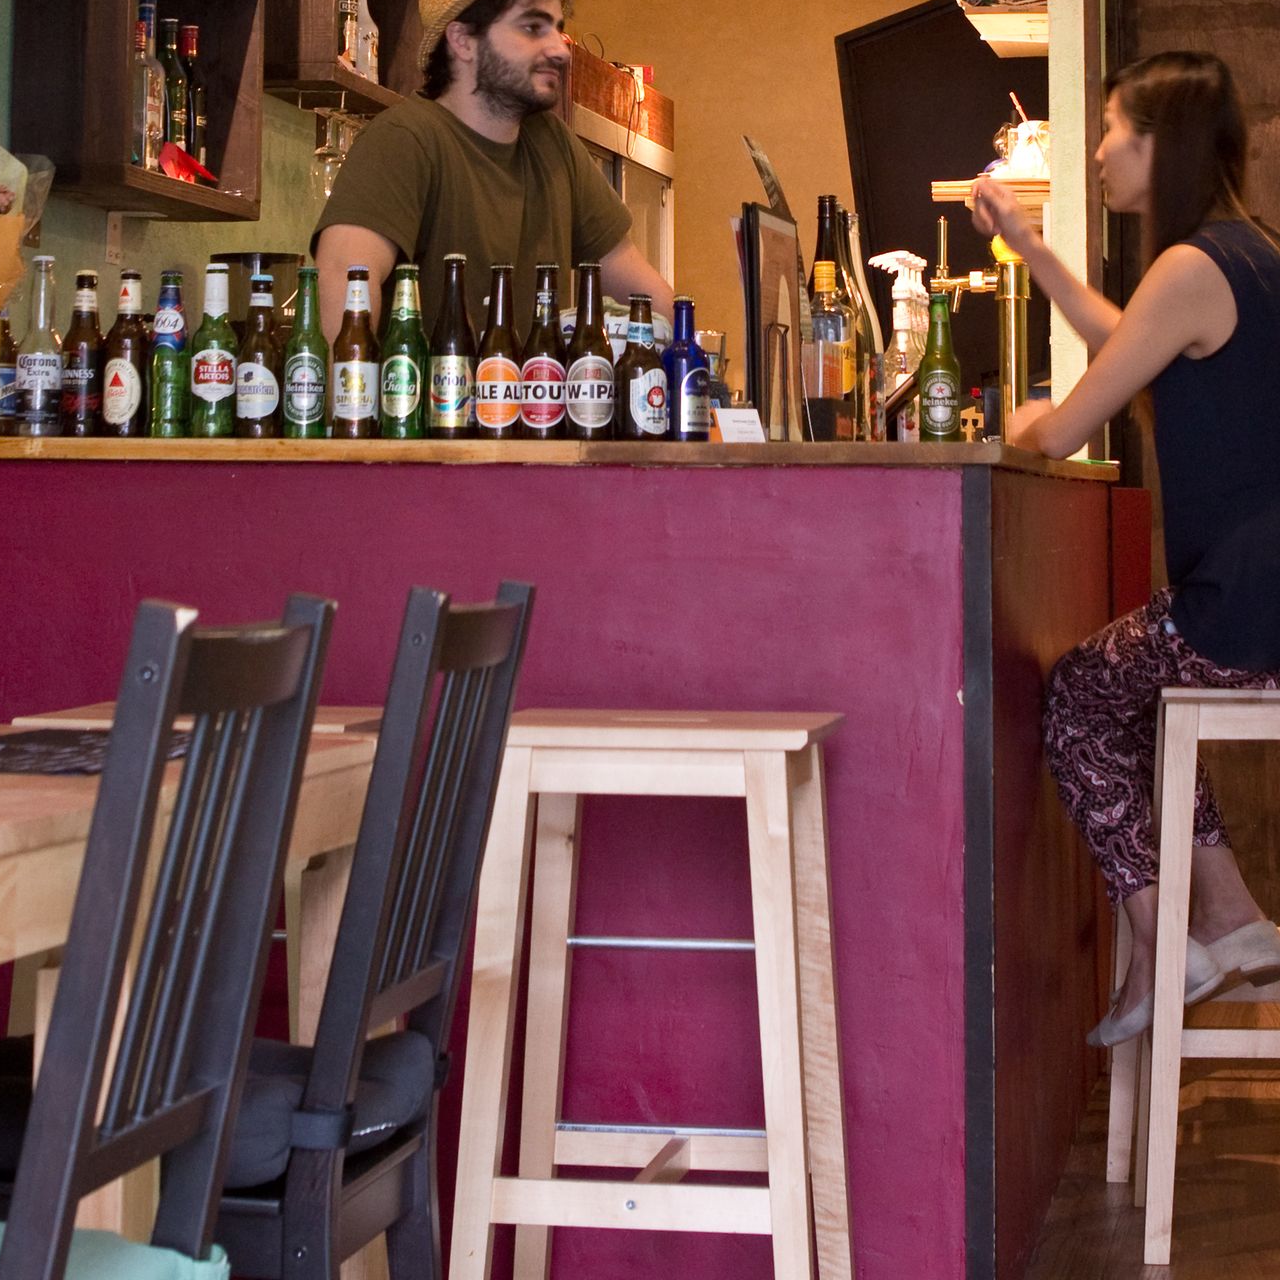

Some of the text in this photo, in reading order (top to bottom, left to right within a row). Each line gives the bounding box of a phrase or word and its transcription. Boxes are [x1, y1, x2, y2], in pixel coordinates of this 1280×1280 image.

[19, 355, 58, 370] Corona
[199, 364, 229, 373] STELLA
[199, 372, 230, 381] ARTOIS
[433, 372, 467, 386] Orion
[285, 383, 325, 394] Heineken
[922, 397, 959, 407] Heineken
